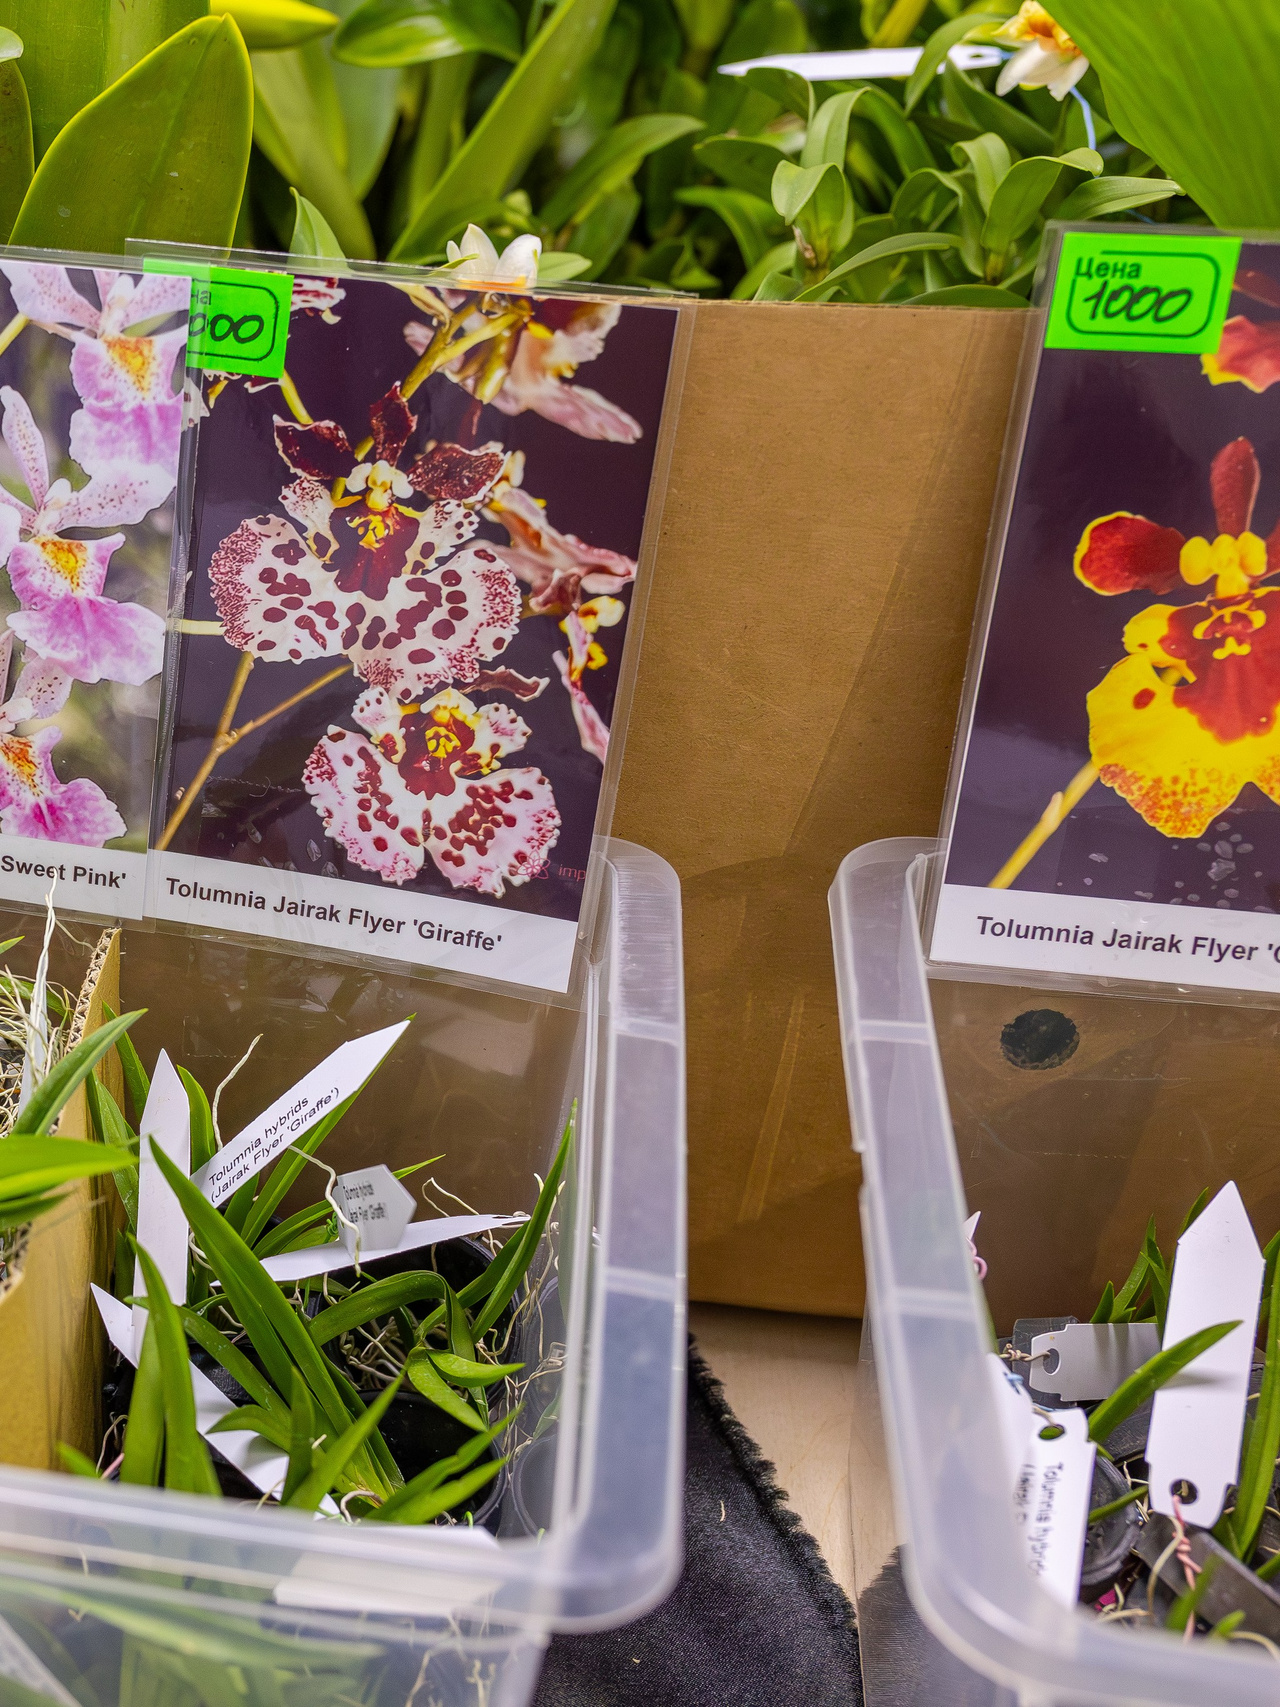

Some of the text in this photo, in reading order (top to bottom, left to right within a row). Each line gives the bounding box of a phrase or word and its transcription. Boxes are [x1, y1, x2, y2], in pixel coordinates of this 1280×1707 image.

[1075, 257, 1142, 280] Цена
[1083, 280, 1193, 322] 1000
[189, 313, 264, 344] 000
[73, 865, 127, 889] Pink'
[166, 877, 502, 951] Tolumnia Jairak Flyer 'Giraffe'
[977, 916, 1095, 946] Tolumnia
[1102, 928, 1183, 954] Jairak
[1191, 936, 1259, 963] Flyer
[209, 1096, 309, 1186] Tolumnia hybrids
[210, 1087, 340, 1203] (Jairak Flyer 'Giraffe')
